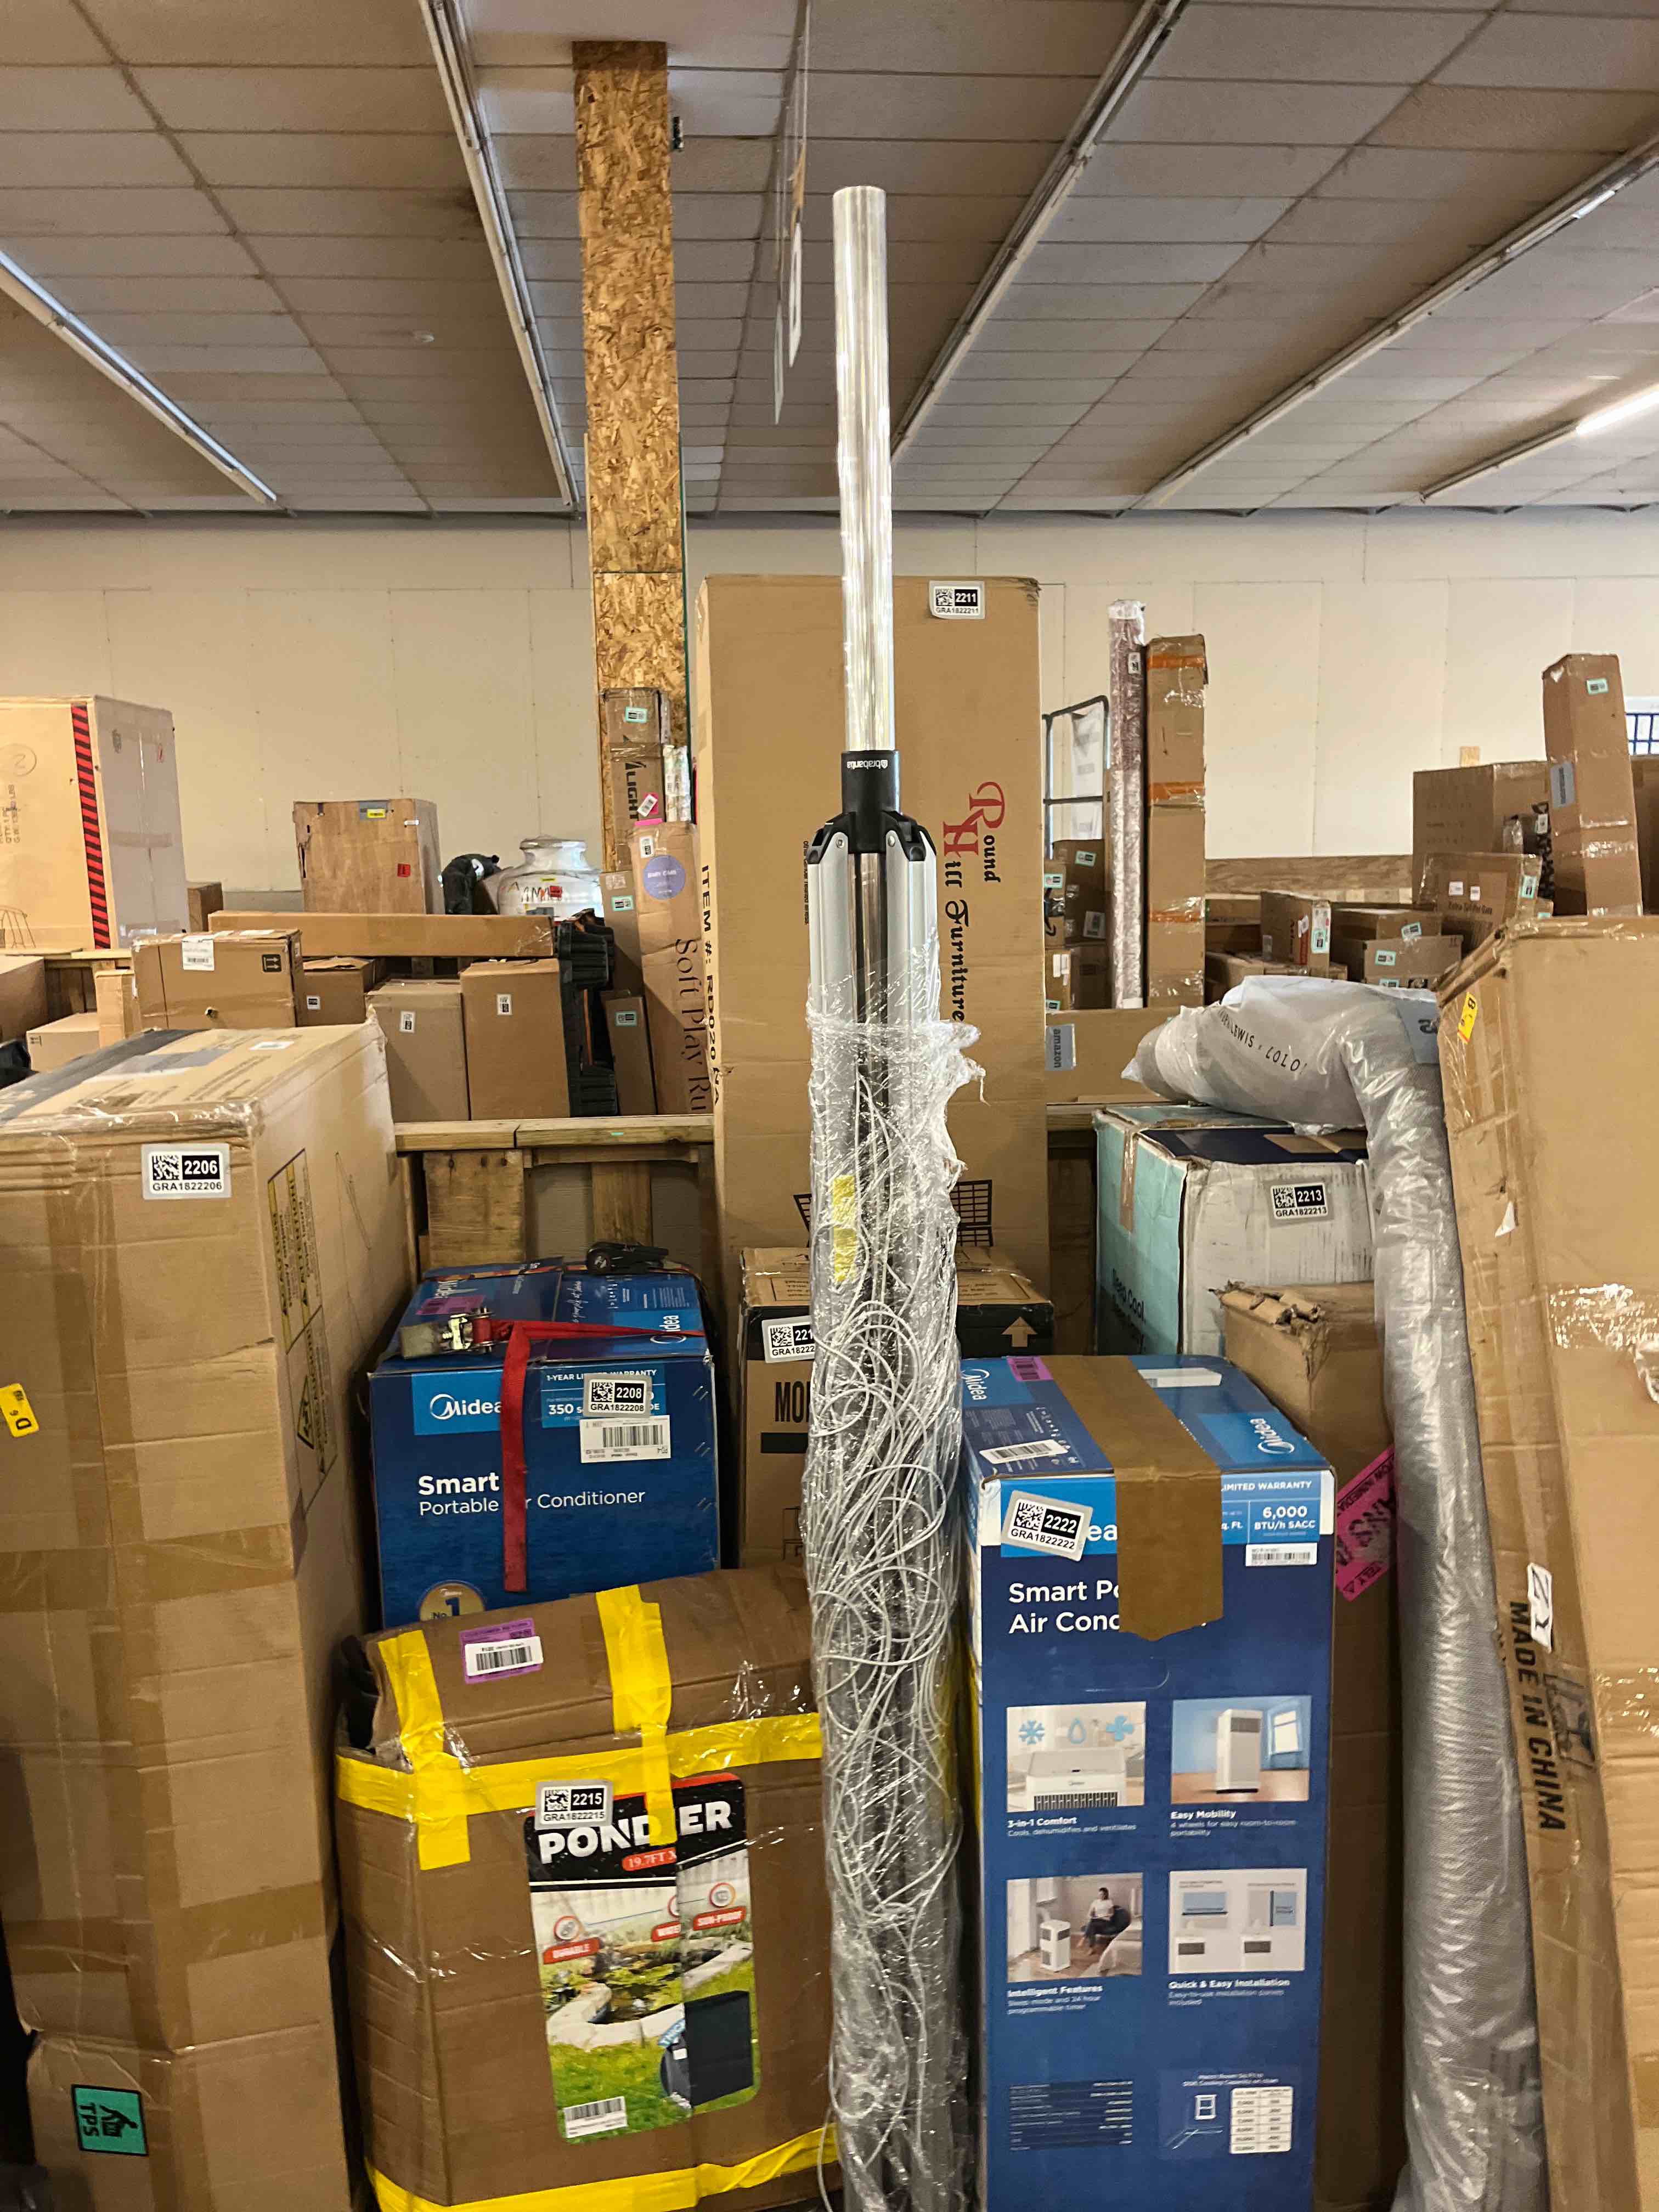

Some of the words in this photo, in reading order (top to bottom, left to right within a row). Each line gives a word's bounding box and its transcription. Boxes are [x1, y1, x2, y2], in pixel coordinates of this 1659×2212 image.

[956, 592, 977, 602] 2211
[702, 865, 712, 932] ITEM
[945, 899, 969, 1022] Furniture
[675, 939, 702, 997] Soft
[681, 1008, 707, 1065] Play
[1053, 1028, 1062, 1069] amazon
[184, 1160, 218, 1175] 2206
[153, 1182, 222, 1191] GRA1822206
[1297, 1189, 1323, 1203] 2213
[1276, 1207, 1327, 1217] GRA1822213
[795, 1328, 812, 1341] 221
[772, 1345, 815, 1356] GRA18222
[616, 1387, 642, 1399] 2208
[549, 1403, 574, 1415] 350
[590, 1403, 644, 1412] GRA1822208
[418, 1472, 500, 1496] Smart
[1258, 1481, 1312, 1490] WARRANTY
[419, 1498, 499, 1516] Portable
[537, 1490, 645, 1509] Conditioner
[1262, 1505, 1308, 1520] 6,000
[1044, 1514, 1077, 1534] 2222
[1254, 1521, 1286, 1531] BTU/h
[1288, 1520, 1316, 1529] SACC
[1011, 1528, 1075, 1550] GRA1822222
[1008, 1581, 1088, 1604] Smart
[1008, 1612, 1048, 1634] Air
[1510, 1601, 1539, 1683] MADE
[1522, 1695, 1548, 1728] IN
[1528, 1736, 1567, 1831] CHINA
[572, 1792, 602, 1806] 2215
[543, 1811, 606, 1821] GRA1822215
[1007, 1818, 1035, 1828] 3-in-1
[1036, 1816, 1077, 1826] Comfort
[1170, 1811, 1194, 1821] Easy
[1195, 1809, 1237, 1819] Mobility
[1169, 1980, 1198, 1989] Quick
[1199, 1980, 1207, 1988] &
[1209, 1979, 1234, 1989] Easy
[1234, 1978, 1290, 1987] Installation
[1007, 1987, 1058, 1997] Intelligent
[1059, 1985, 1103, 1994] Features
[78, 2102, 99, 2137] TPS
